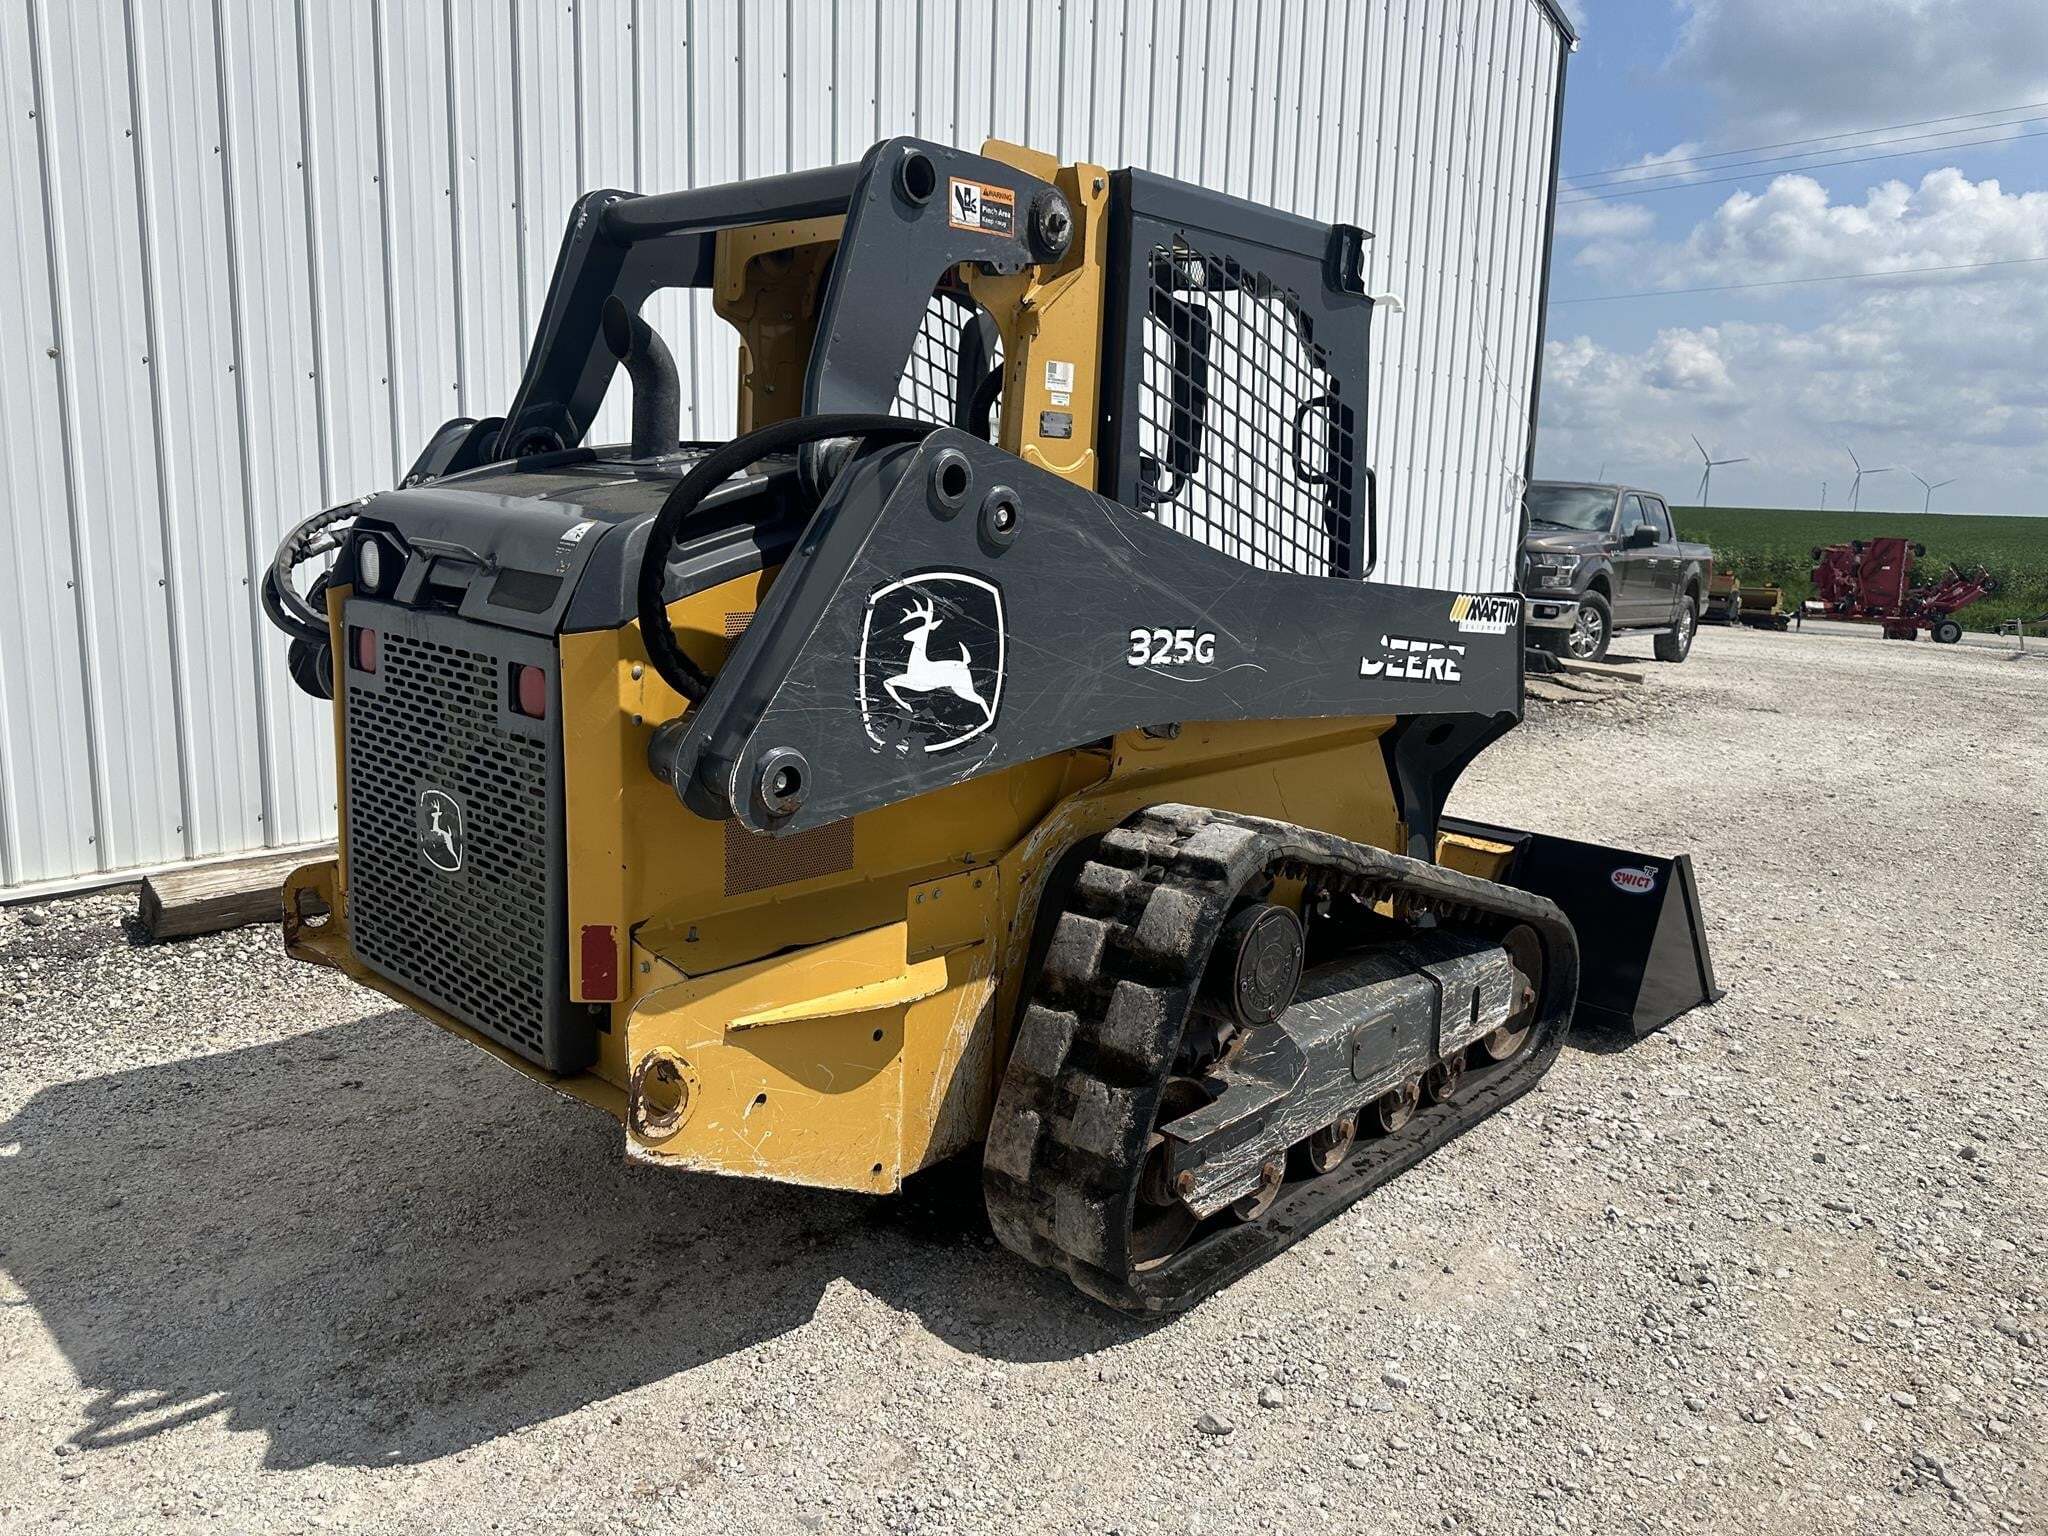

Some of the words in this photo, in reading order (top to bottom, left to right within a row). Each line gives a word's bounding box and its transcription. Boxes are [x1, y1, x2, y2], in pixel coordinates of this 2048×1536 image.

[987, 190, 1013, 202] WARNING
[981, 215, 994, 226] Keep
[998, 209, 1011, 219] Area
[1465, 597, 1519, 625] MARTIN
[1128, 628, 1216, 666] 325G
[1613, 871, 1651, 889] SWICT
